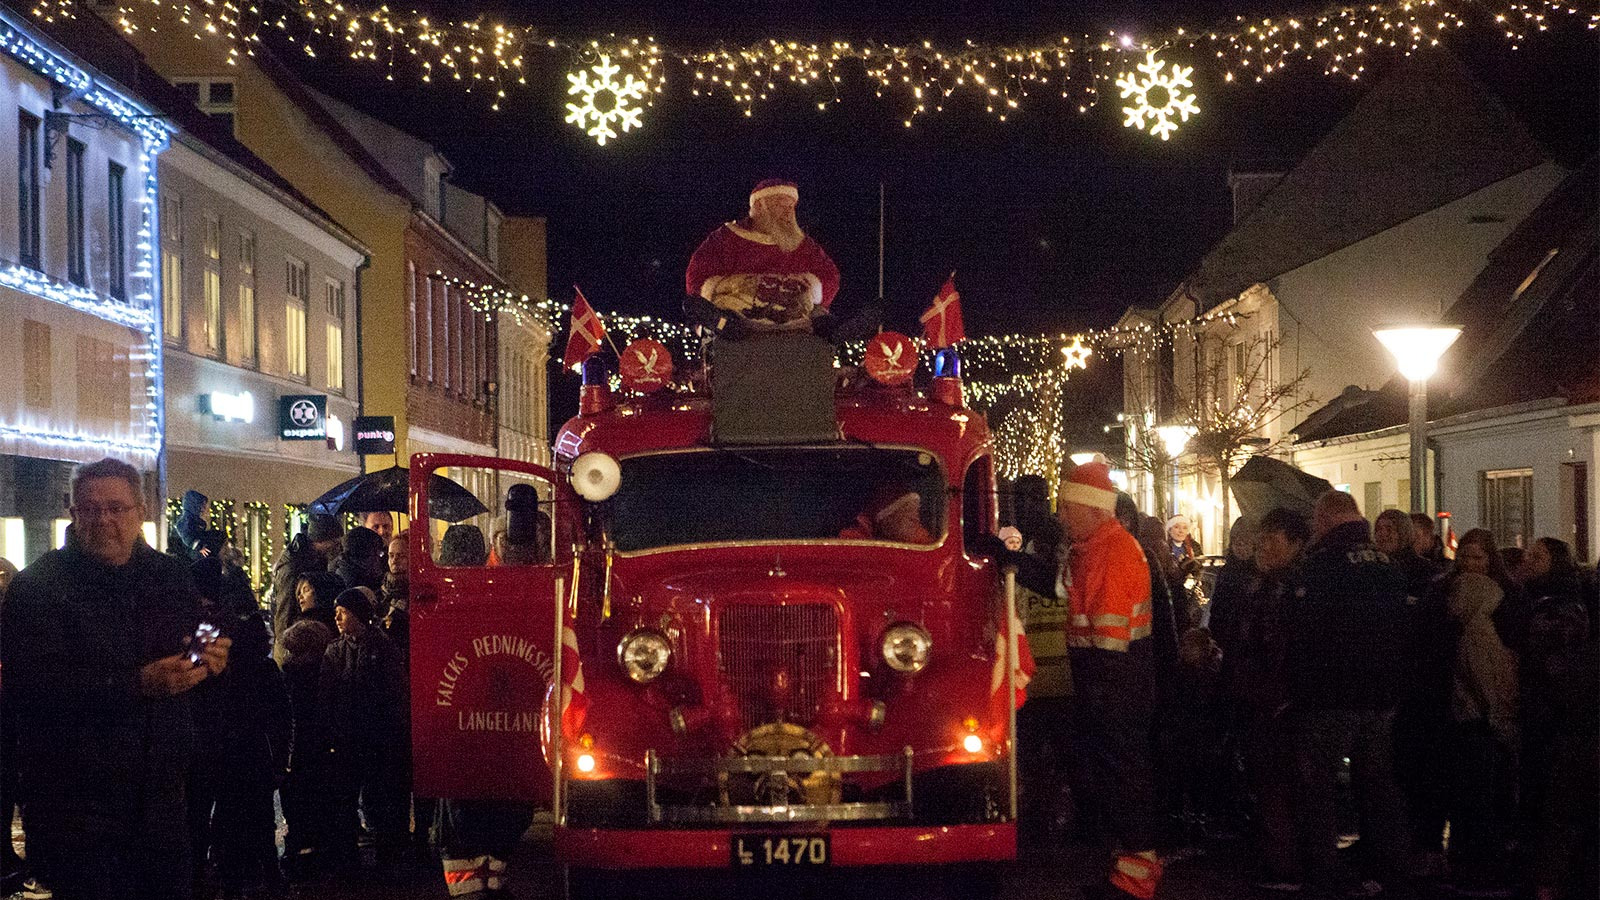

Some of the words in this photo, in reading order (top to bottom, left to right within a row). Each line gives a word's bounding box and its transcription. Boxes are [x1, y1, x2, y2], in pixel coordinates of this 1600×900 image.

[283, 428, 325, 438] expert
[436, 651, 469, 707] FALCKS
[763, 837, 826, 865] 1470
